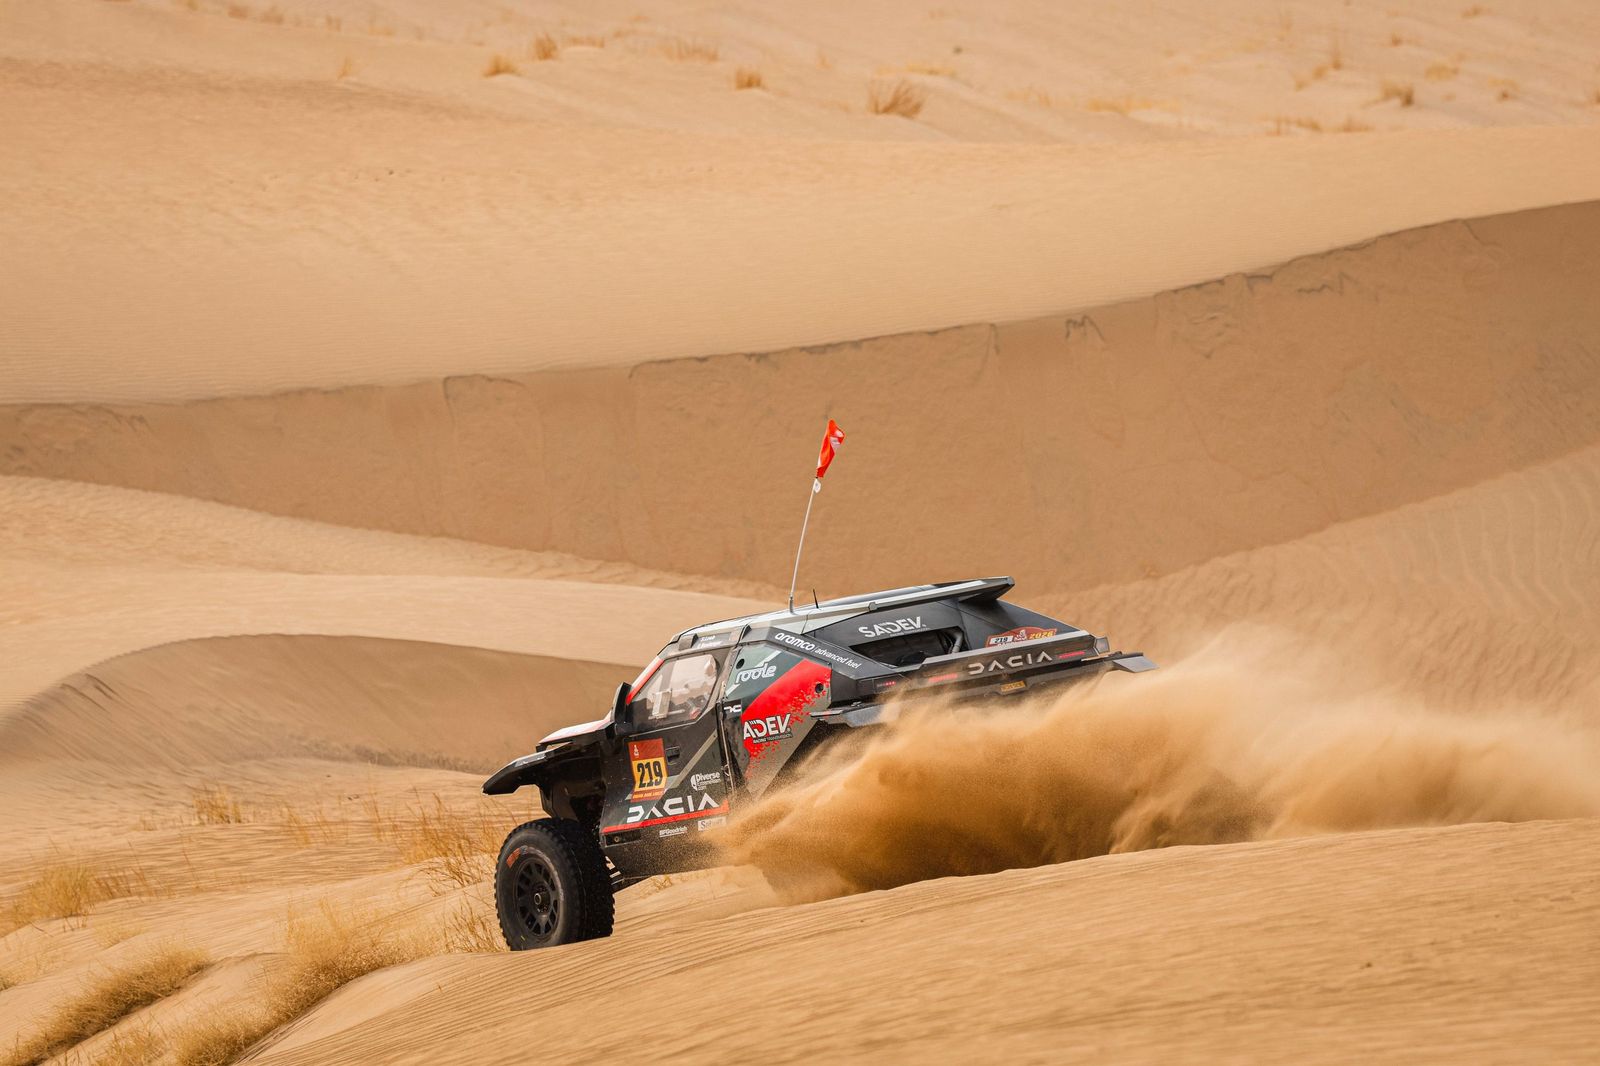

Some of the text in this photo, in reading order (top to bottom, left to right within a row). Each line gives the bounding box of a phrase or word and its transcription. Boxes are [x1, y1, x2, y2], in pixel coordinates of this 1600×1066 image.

[859, 616, 921, 638] SADEV
[774, 632, 862, 669] aramco advanced fuel
[967, 651, 1053, 676] DACIA
[636, 760, 663, 788] 219
[695, 771, 721, 784] Diverse
[626, 792, 720, 824] DACIA
